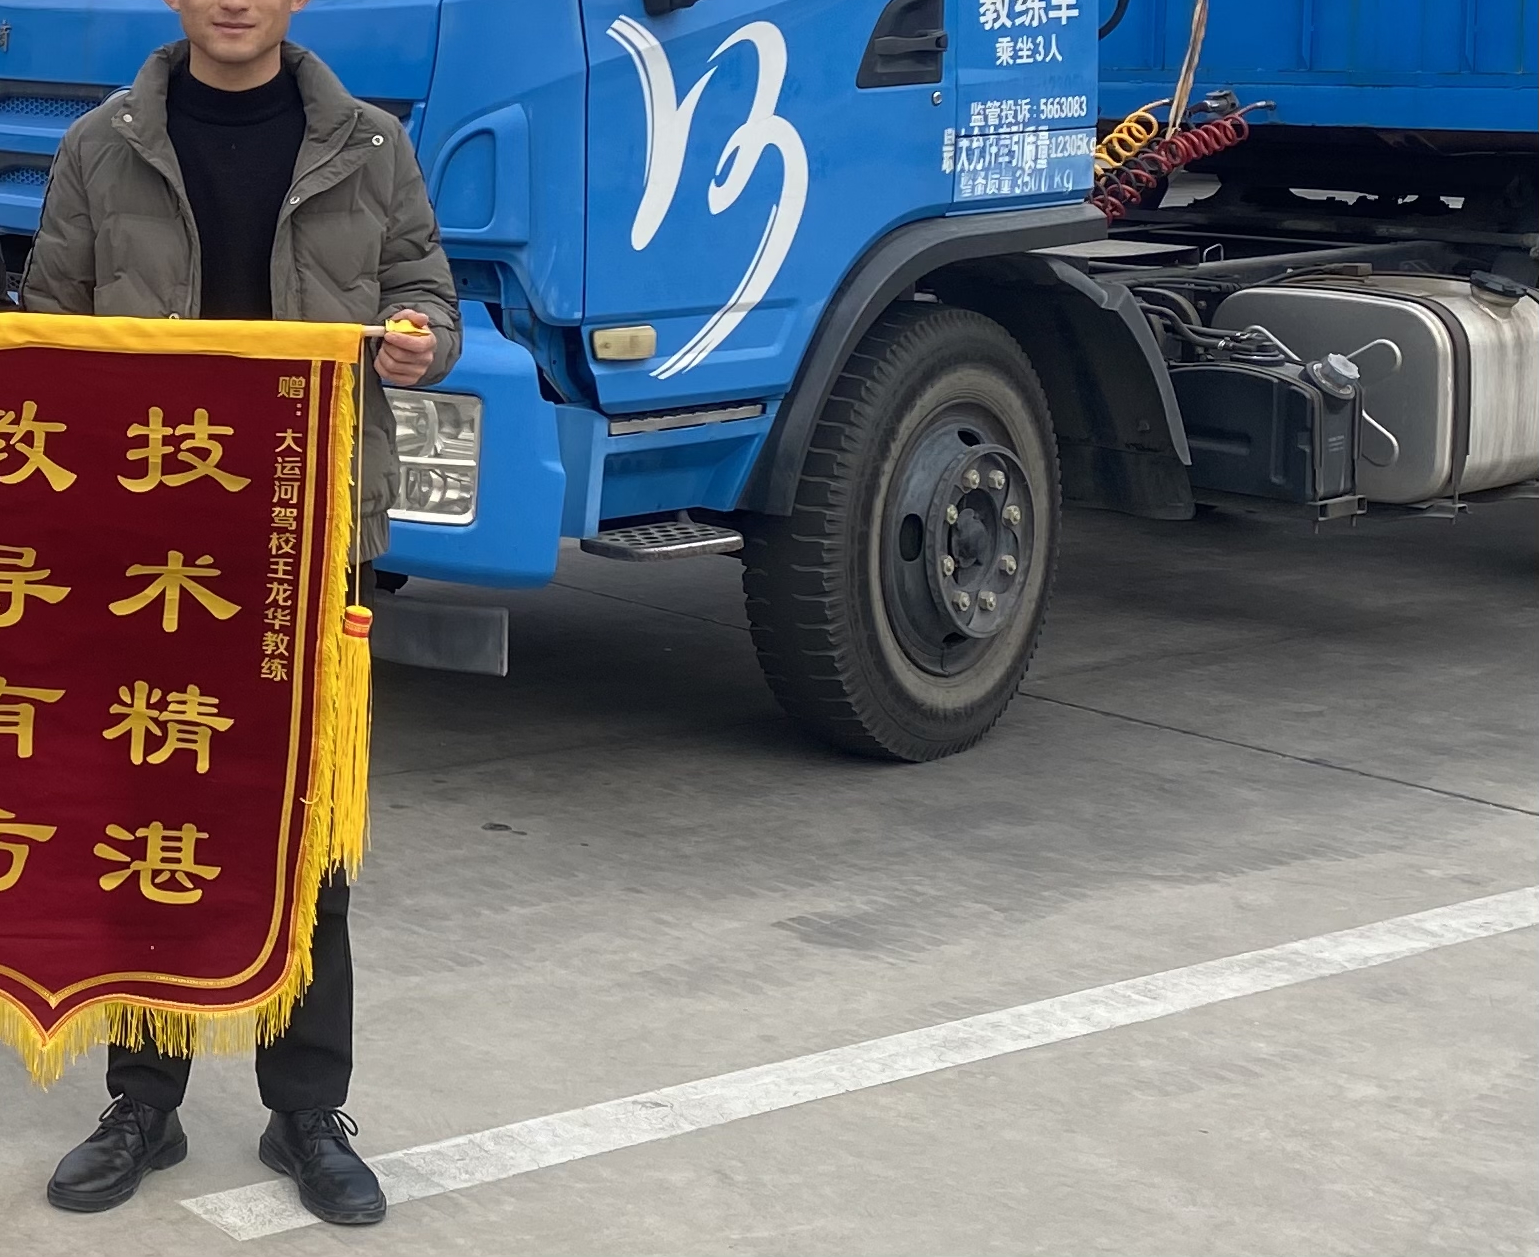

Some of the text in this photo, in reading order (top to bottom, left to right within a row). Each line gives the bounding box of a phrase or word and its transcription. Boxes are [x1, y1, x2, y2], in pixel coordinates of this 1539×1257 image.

[995, 34, 1063, 66] 乘坐3人
[93, 406, 252, 905] 技术精湛
